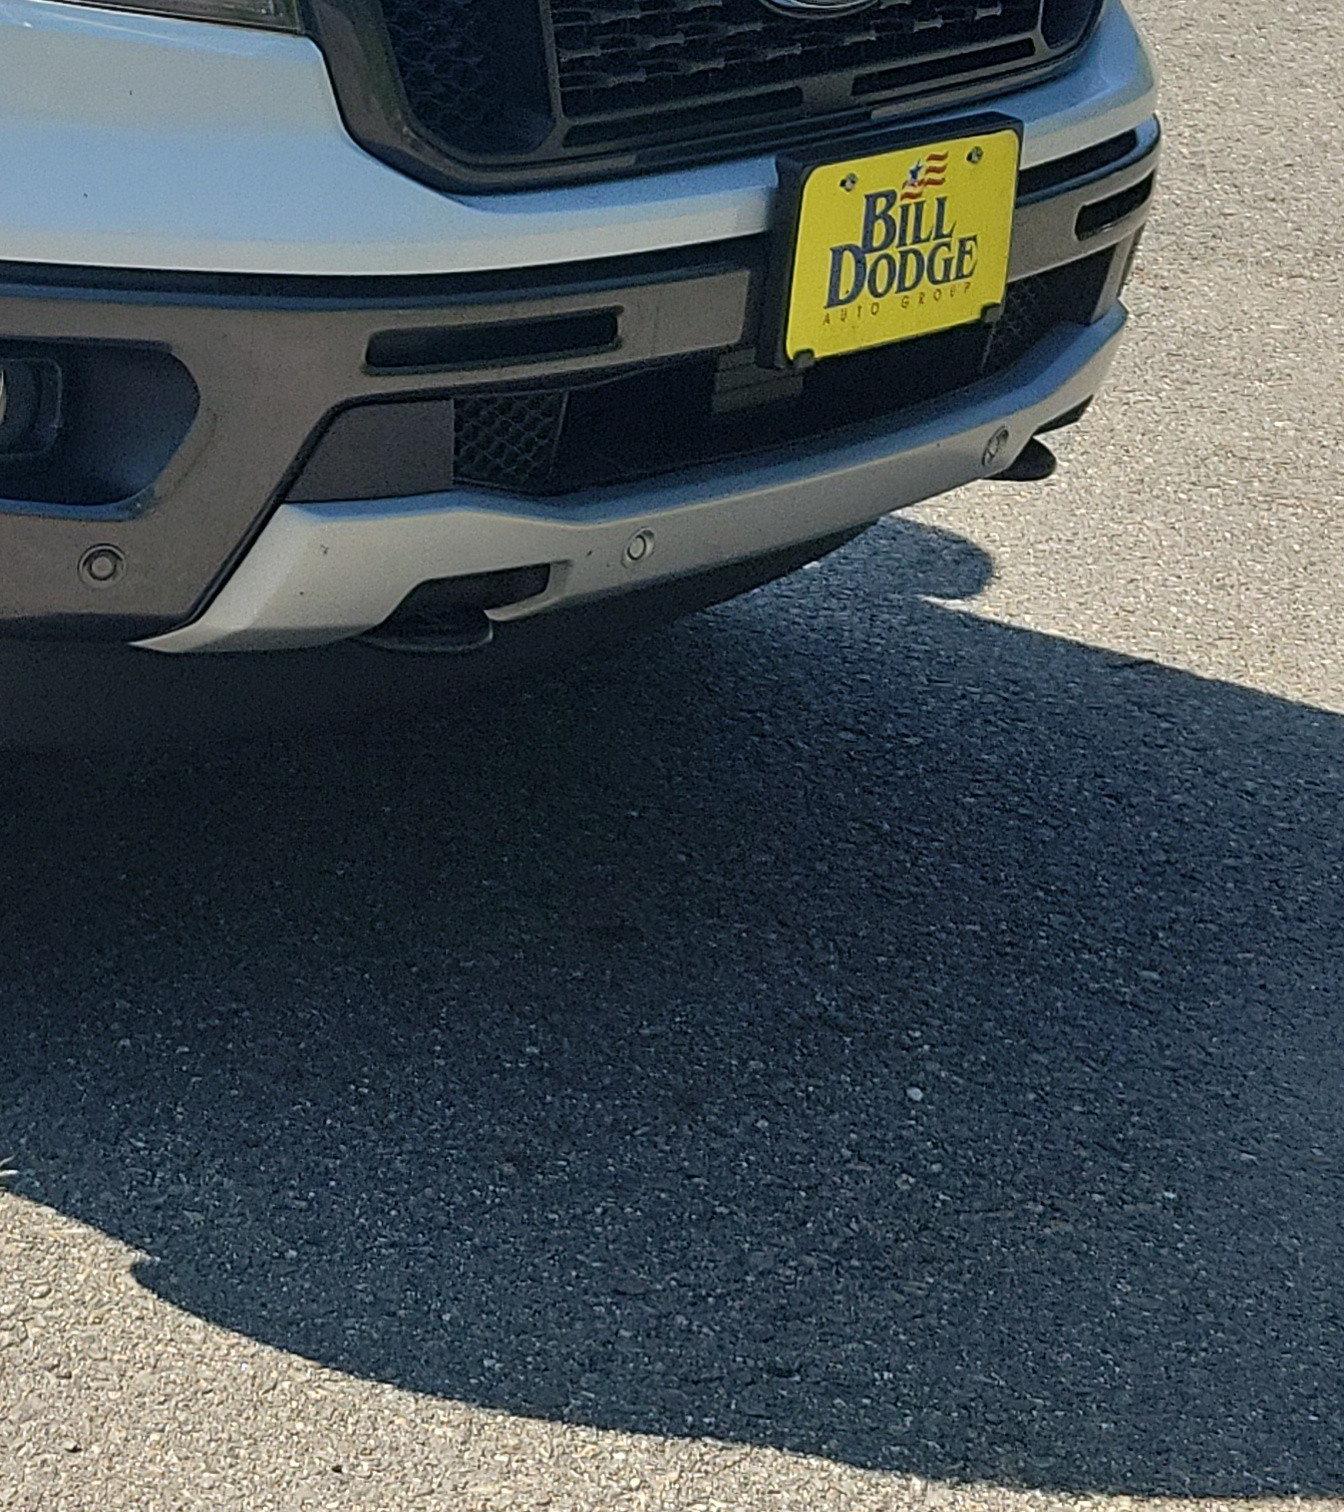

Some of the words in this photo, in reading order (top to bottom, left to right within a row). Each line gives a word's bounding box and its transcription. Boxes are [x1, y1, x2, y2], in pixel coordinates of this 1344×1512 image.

[862, 189, 957, 254] BILL
[823, 301, 880, 326] AUTO
[901, 282, 972, 309] GROUP
[824, 235, 978, 309] DODGE
